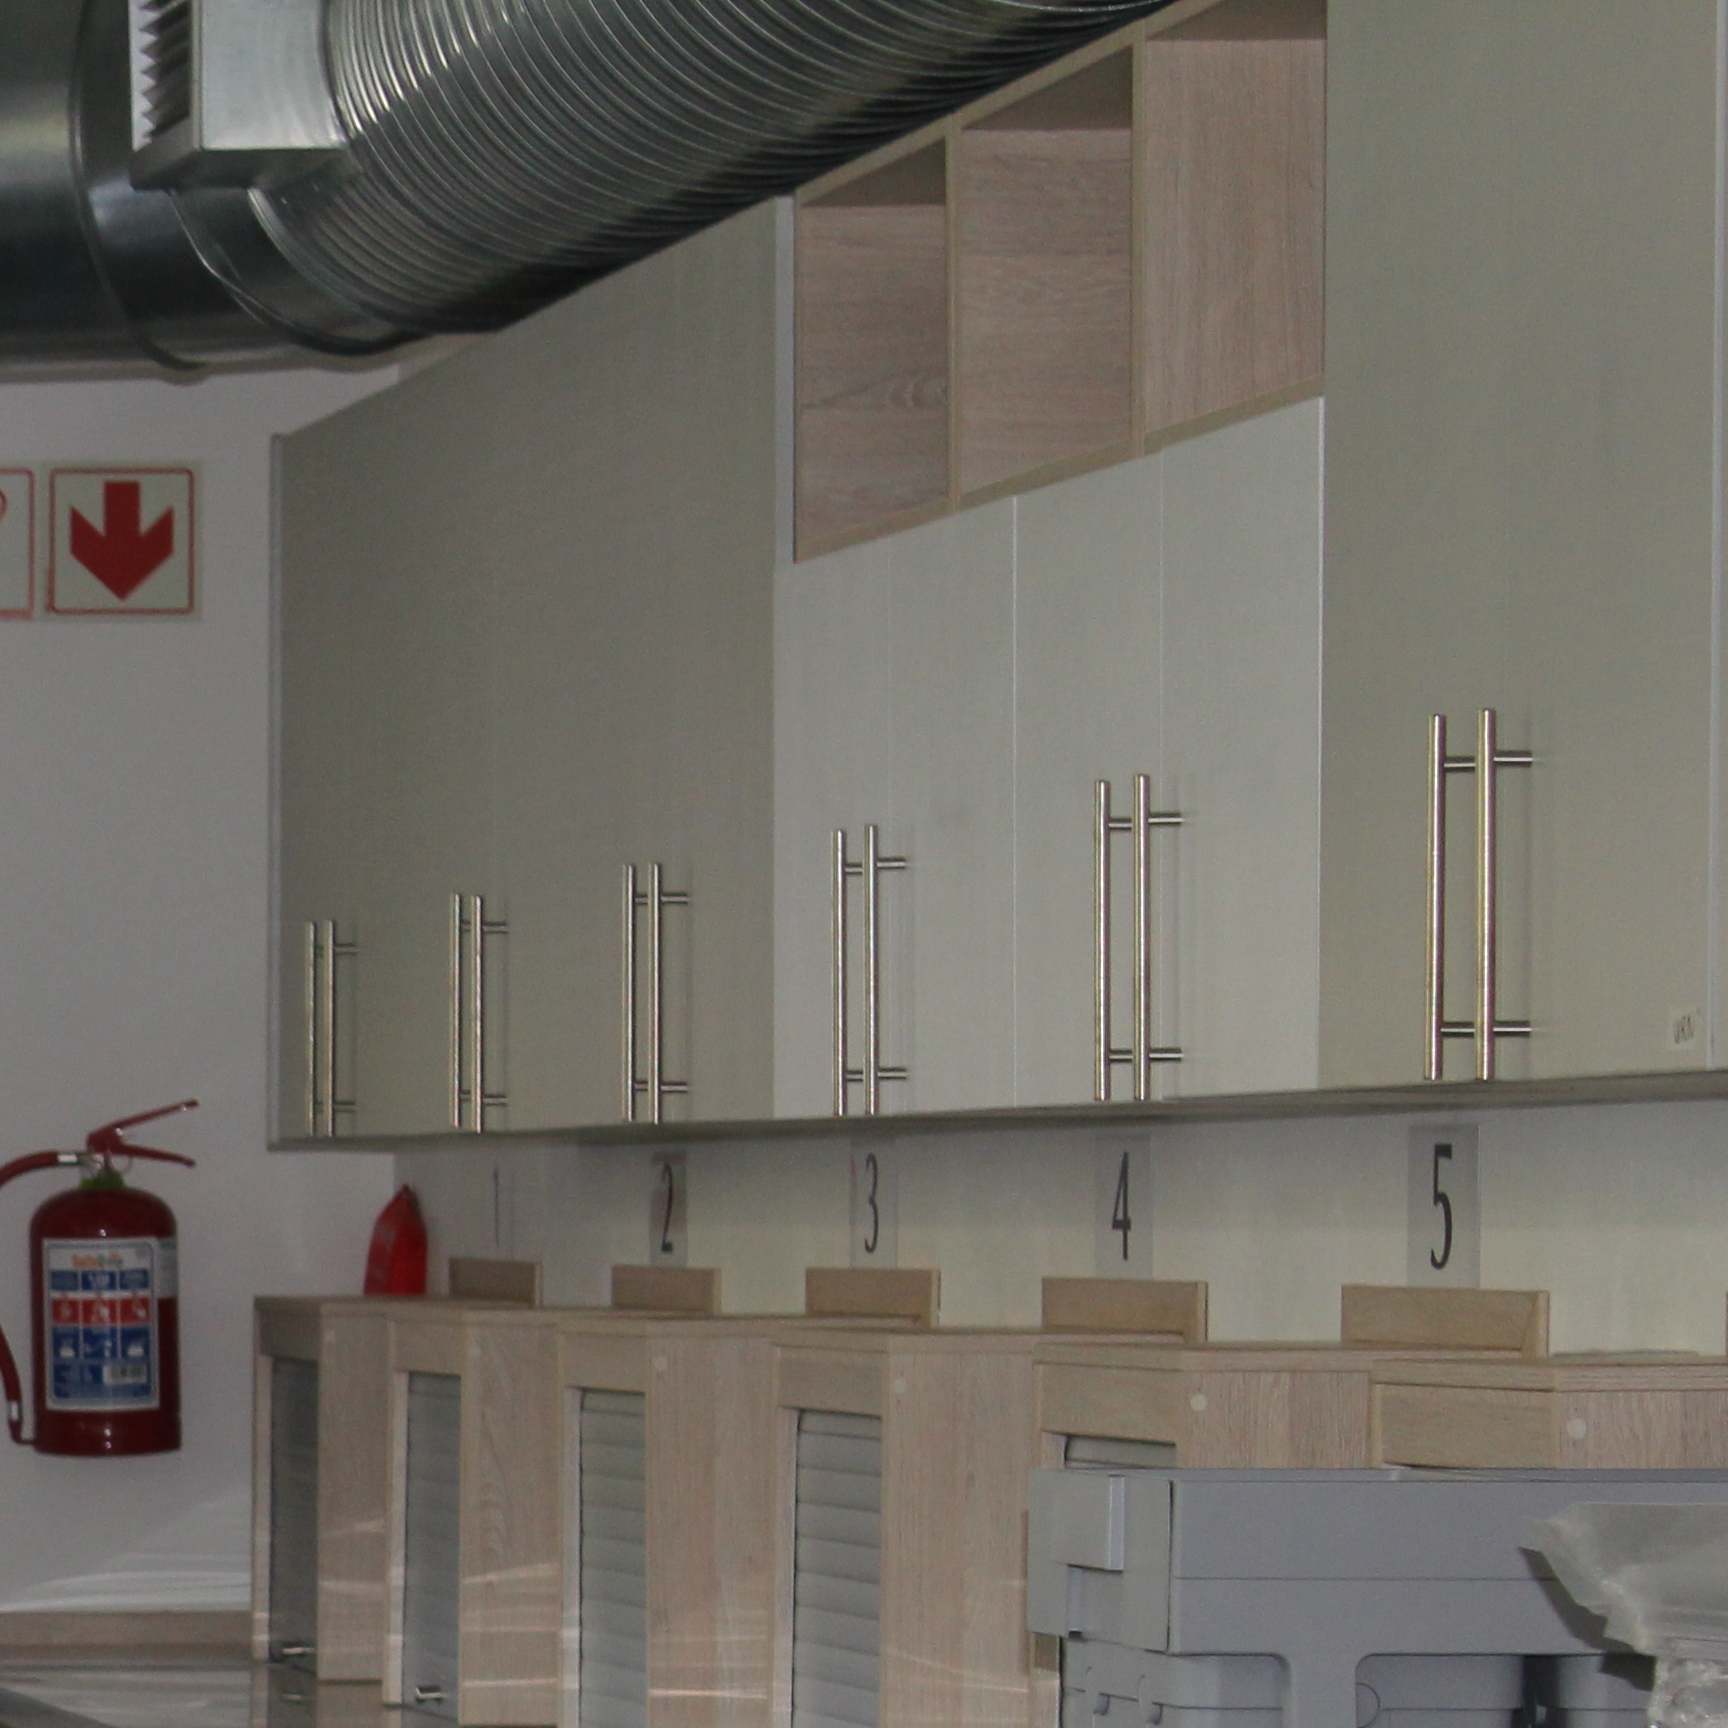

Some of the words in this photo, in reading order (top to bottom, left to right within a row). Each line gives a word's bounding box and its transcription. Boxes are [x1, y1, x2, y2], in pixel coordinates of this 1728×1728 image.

[660, 1162, 674, 1253] 2
[864, 1152, 880, 1254] 3
[1110, 1150, 1132, 1262] 4
[1430, 1143, 1453, 1270] 5
